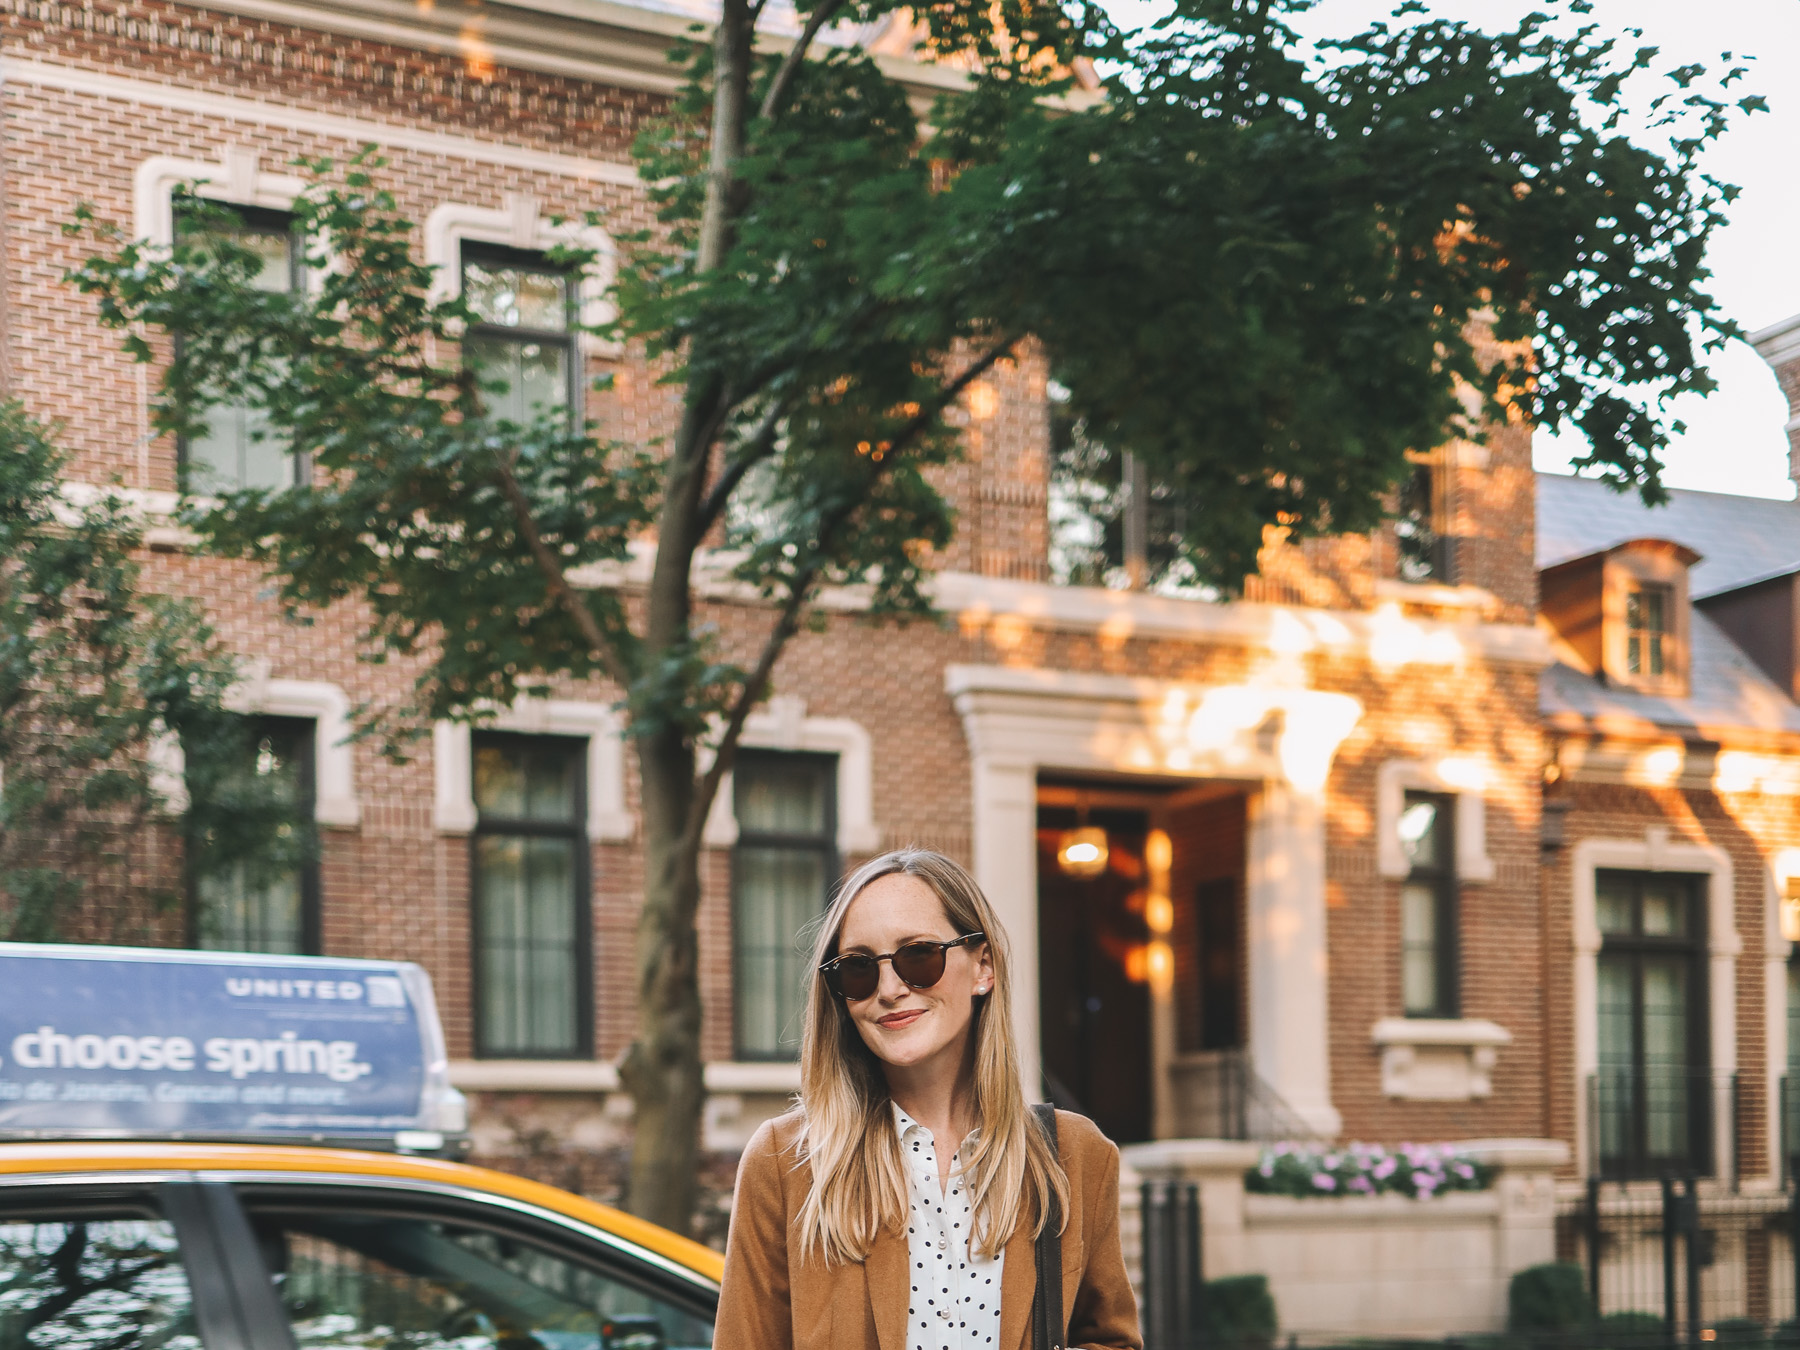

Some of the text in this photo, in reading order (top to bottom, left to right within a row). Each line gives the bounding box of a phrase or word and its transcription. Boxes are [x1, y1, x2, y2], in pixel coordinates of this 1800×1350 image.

[225, 977, 364, 1000] UNITED
[12, 1025, 371, 1082] choose spring.
